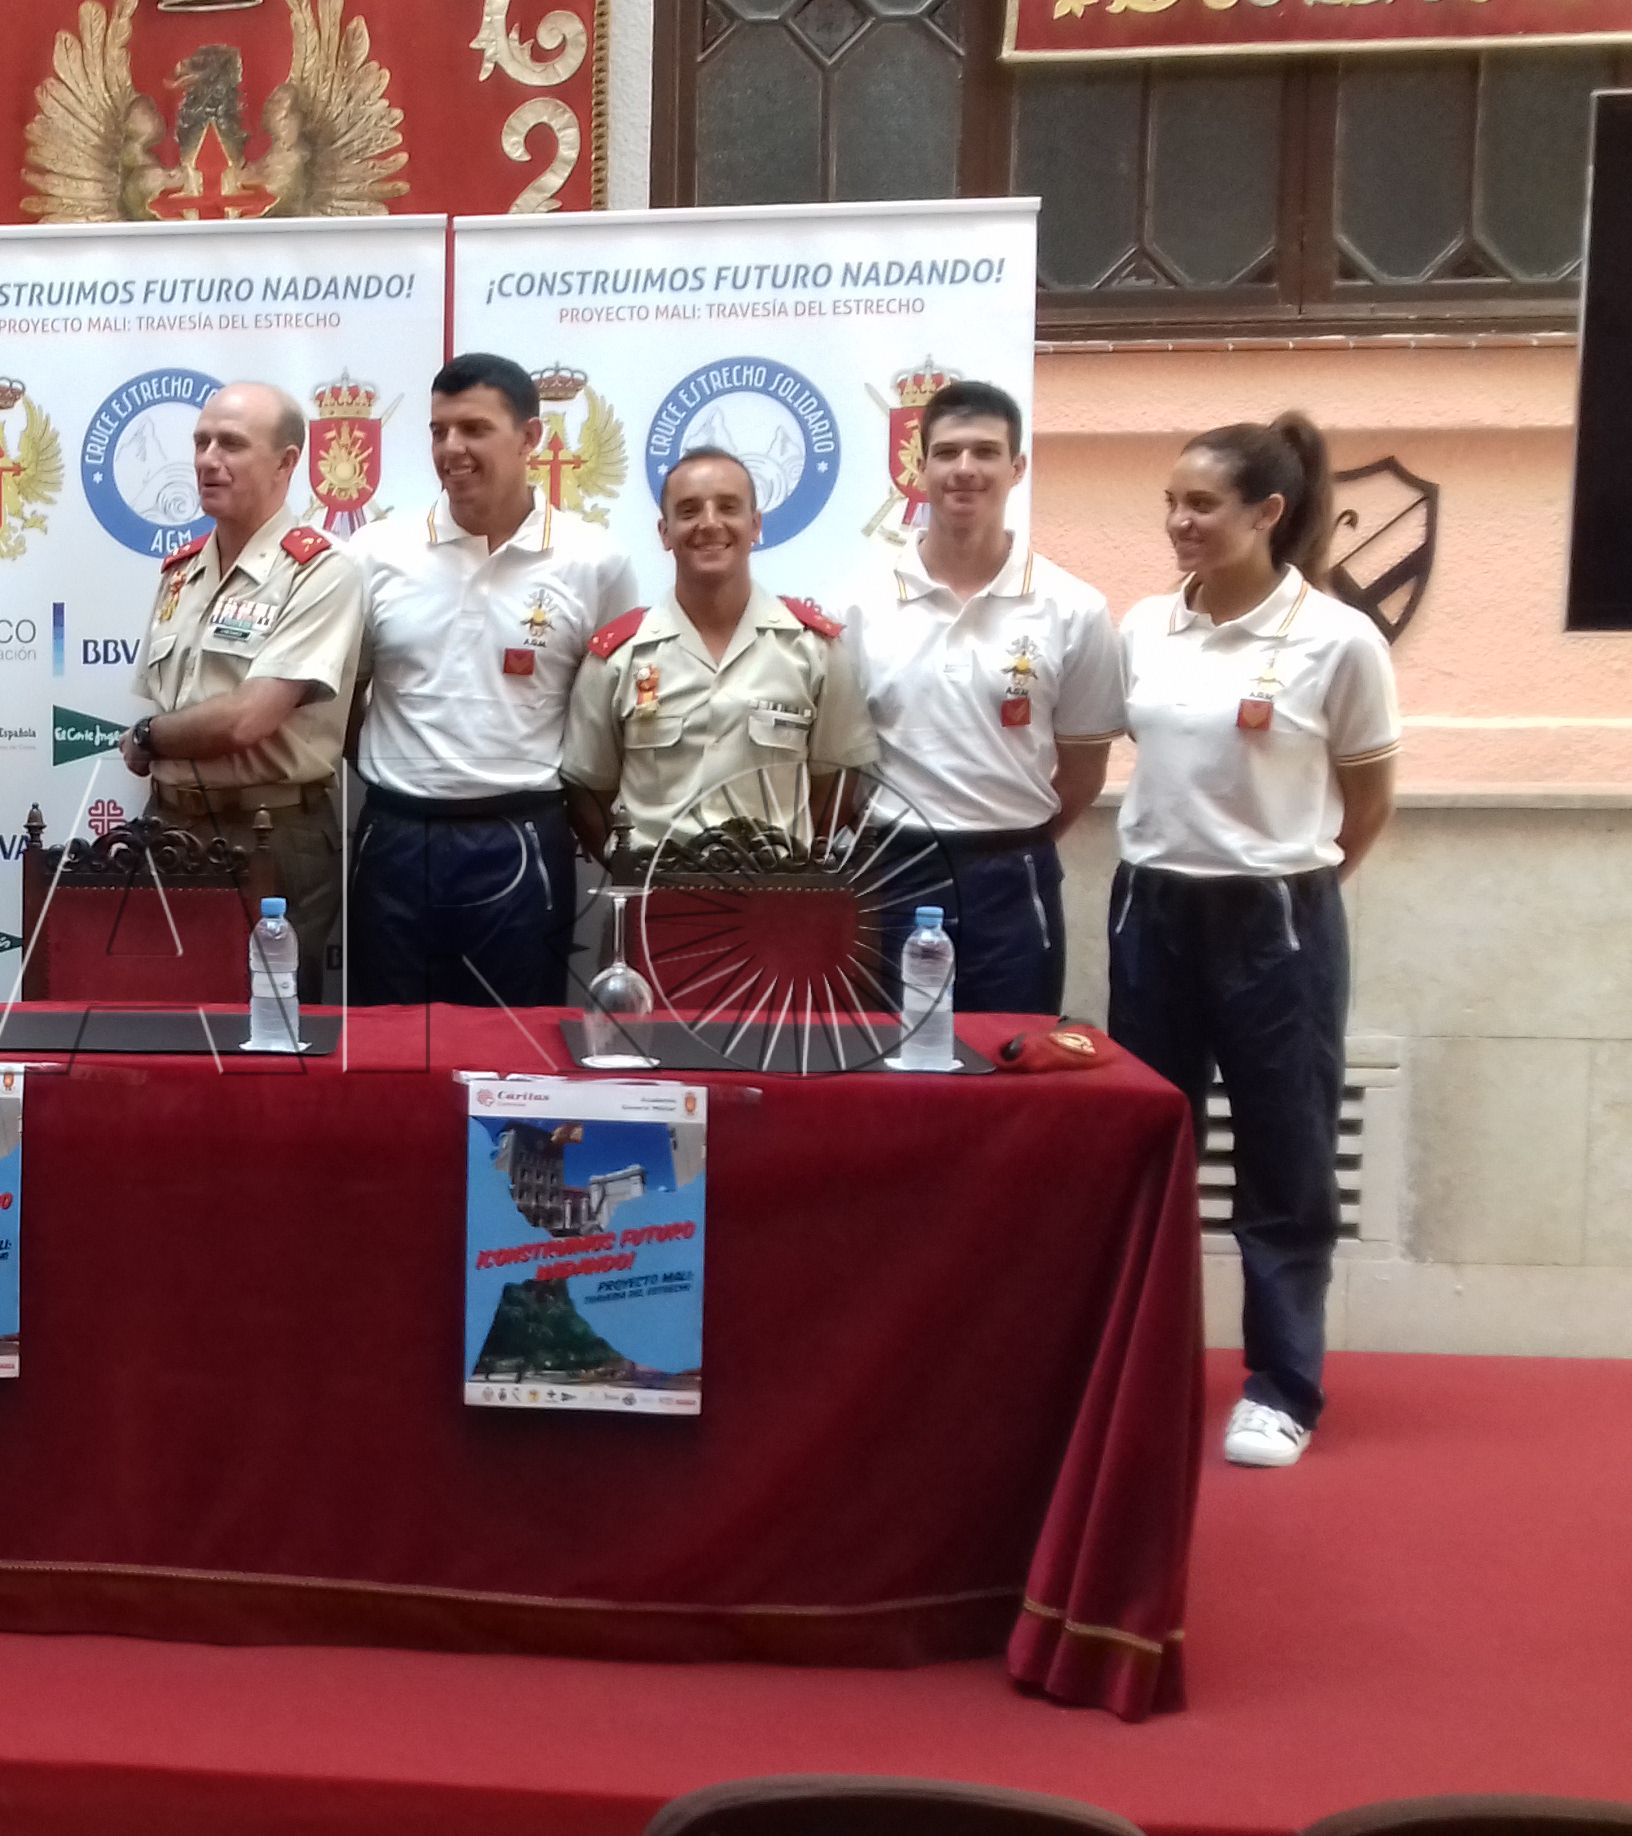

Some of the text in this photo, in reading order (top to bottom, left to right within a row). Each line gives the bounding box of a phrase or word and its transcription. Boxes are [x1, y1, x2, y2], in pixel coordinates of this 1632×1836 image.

[143, 278, 255, 304] FUTURO
[261, 274, 415, 303] NADANDO!
[486, 258, 1006, 303] ¡CONSTRUIMOS FUTURO NADANDO!
[88, 316, 131, 332] MALI:
[136, 311, 213, 332] TRAVESÍA
[218, 314, 250, 330] DEL
[255, 312, 341, 329] ESTRECHO
[559, 297, 925, 323] PROYECTO MALI: TRAVESÍA DEL ESTRECHO
[85, 411, 119, 465] CRUCE
[111, 376, 194, 419] ESTRECHO
[650, 365, 835, 456] CRUCE ESTRECHO SOLIDARIO
[82, 639, 141, 665] BBV
